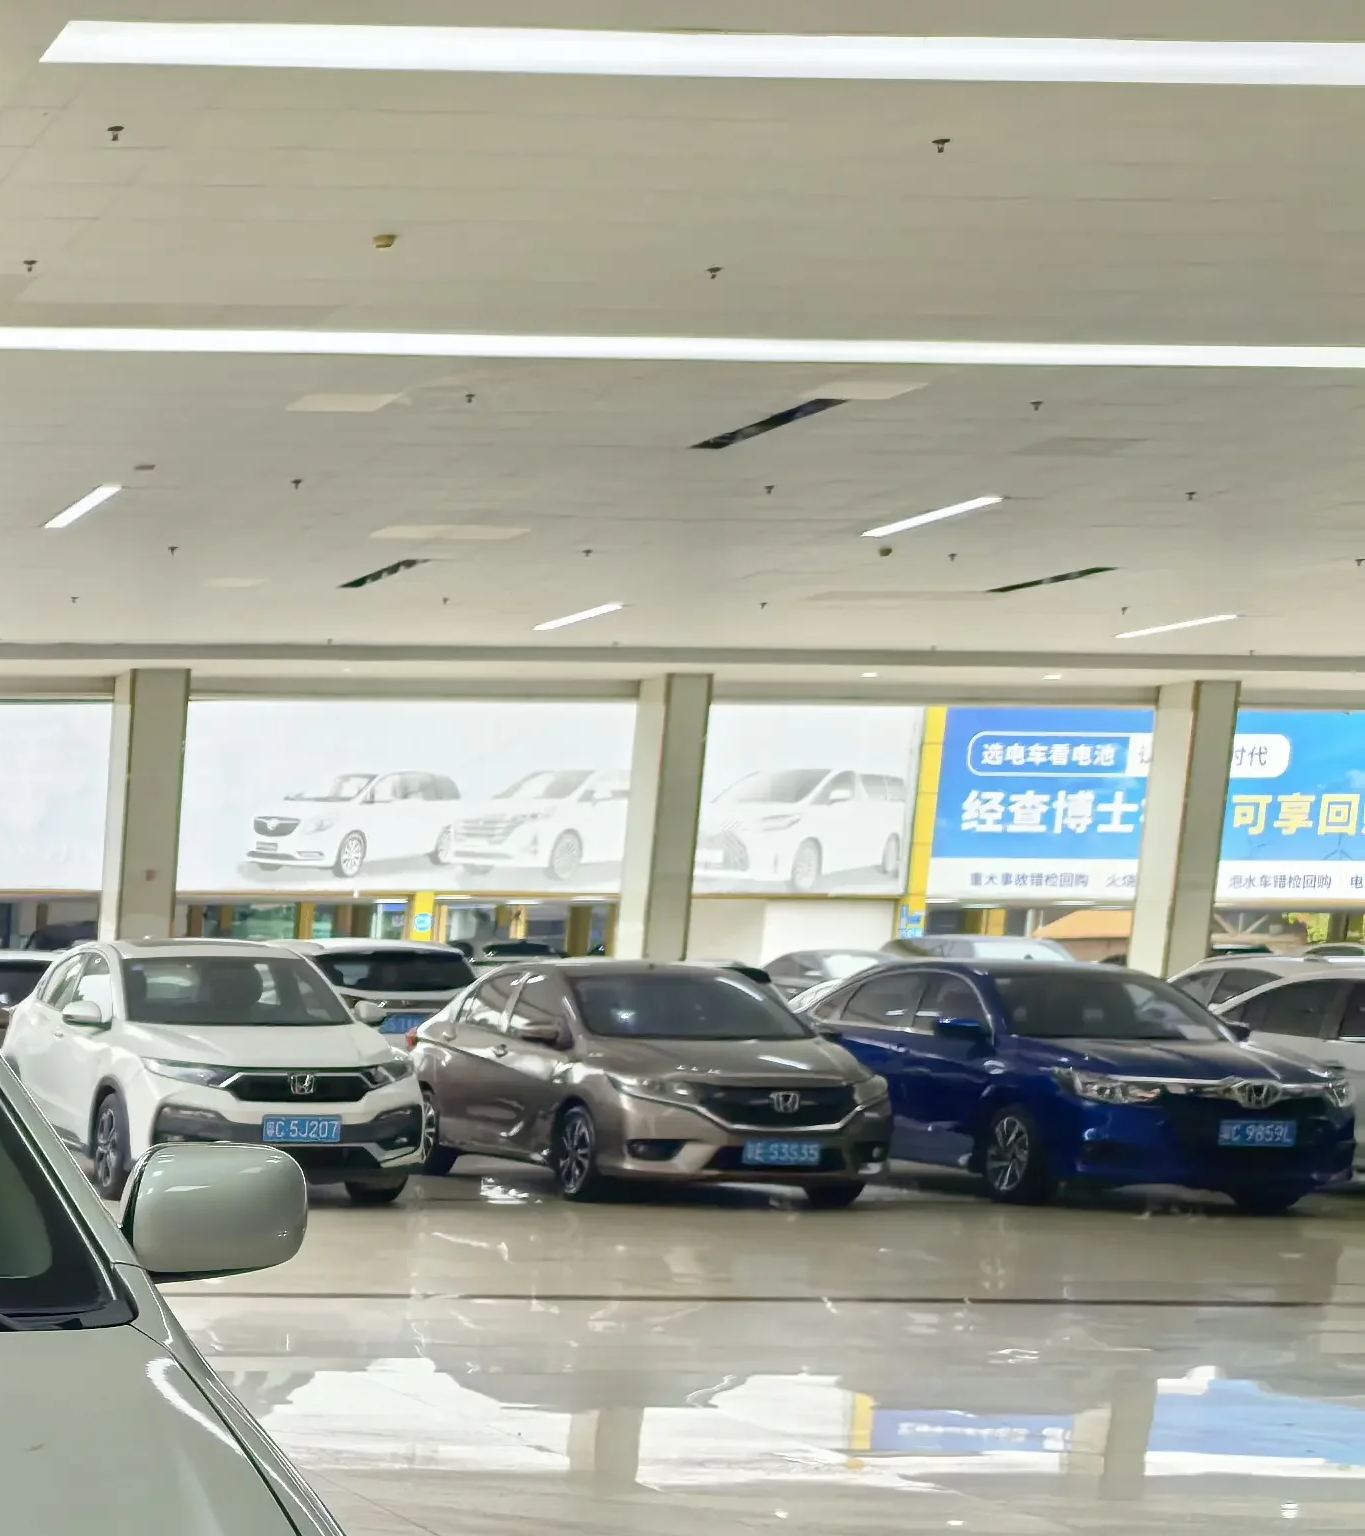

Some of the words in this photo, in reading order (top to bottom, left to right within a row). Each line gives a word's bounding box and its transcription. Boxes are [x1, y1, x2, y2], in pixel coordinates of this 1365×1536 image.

[981, 742, 1119, 767] 选电车看电池
[961, 789, 1147, 834] 经查博士
[1232, 792, 1365, 836] 可享回
